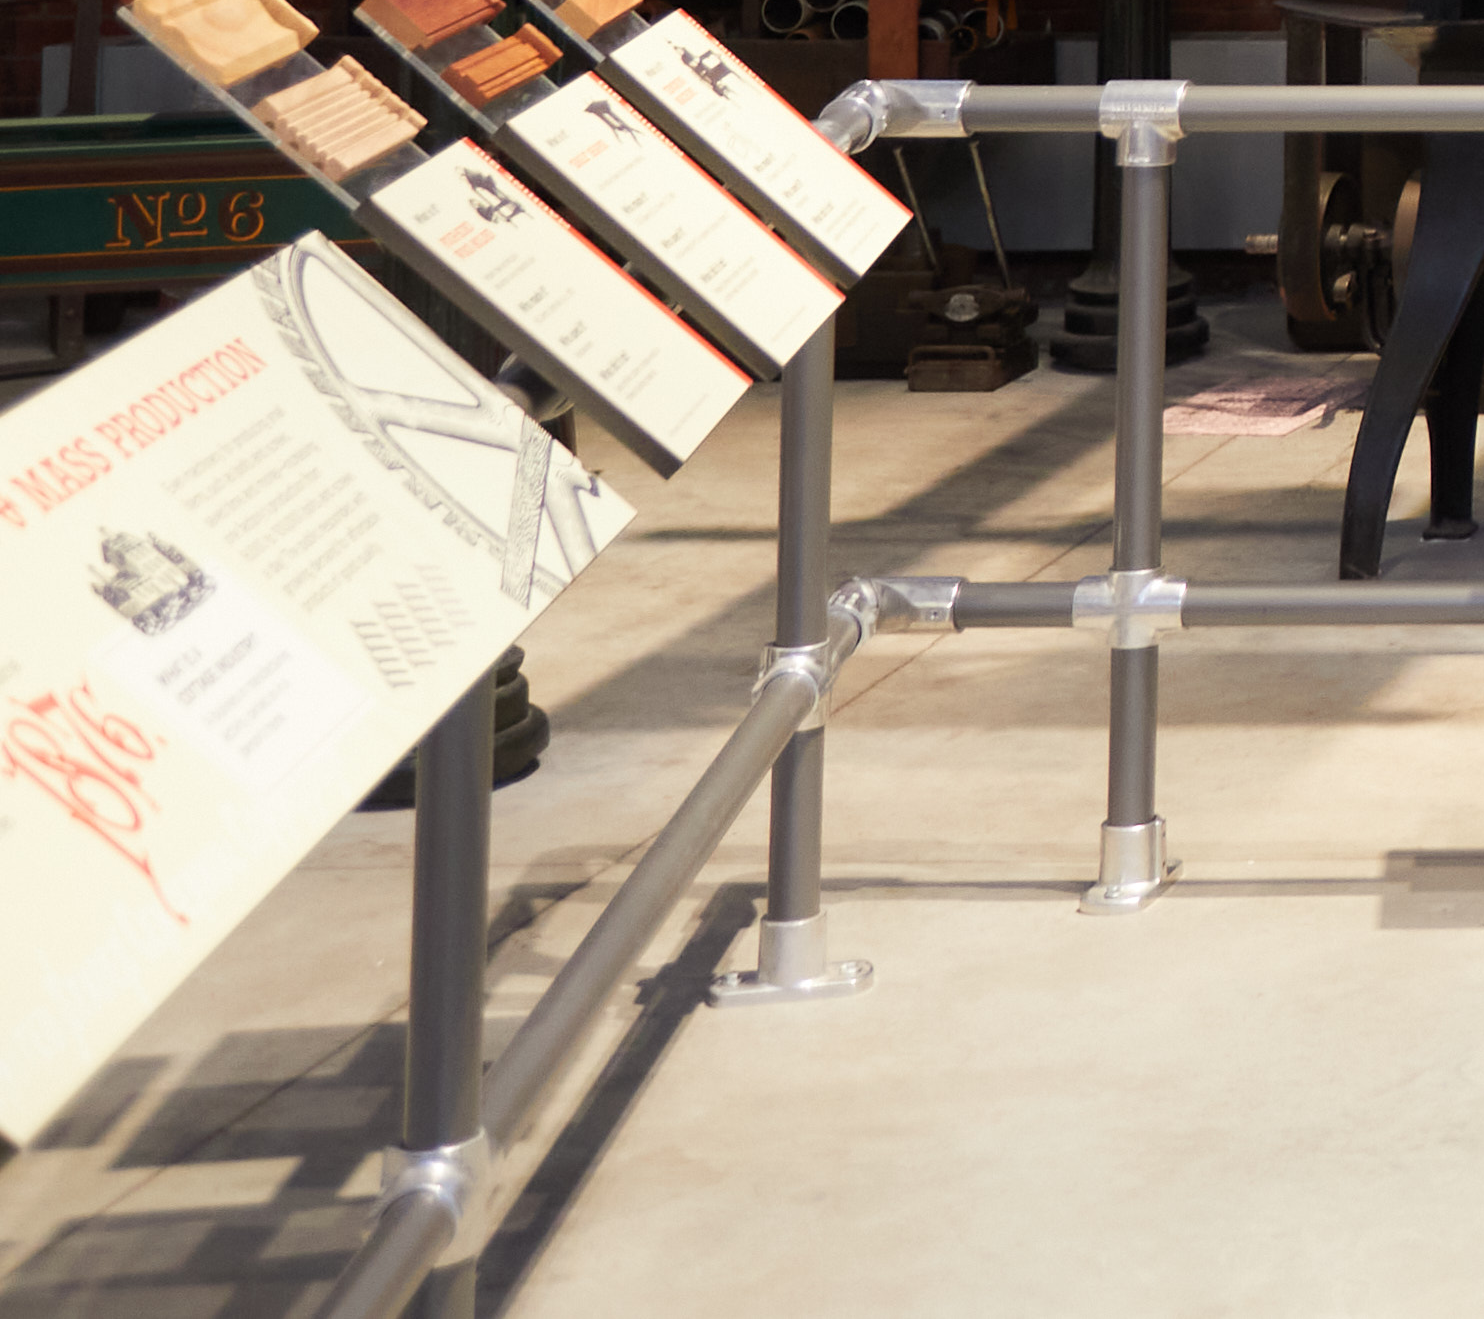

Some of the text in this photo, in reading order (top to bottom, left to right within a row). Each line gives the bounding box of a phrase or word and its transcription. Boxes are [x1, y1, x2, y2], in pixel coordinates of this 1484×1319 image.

[219, 190, 264, 242] 6
[24, 433, 113, 514] MASS
[94, 336, 269, 460] PRODUCTION
